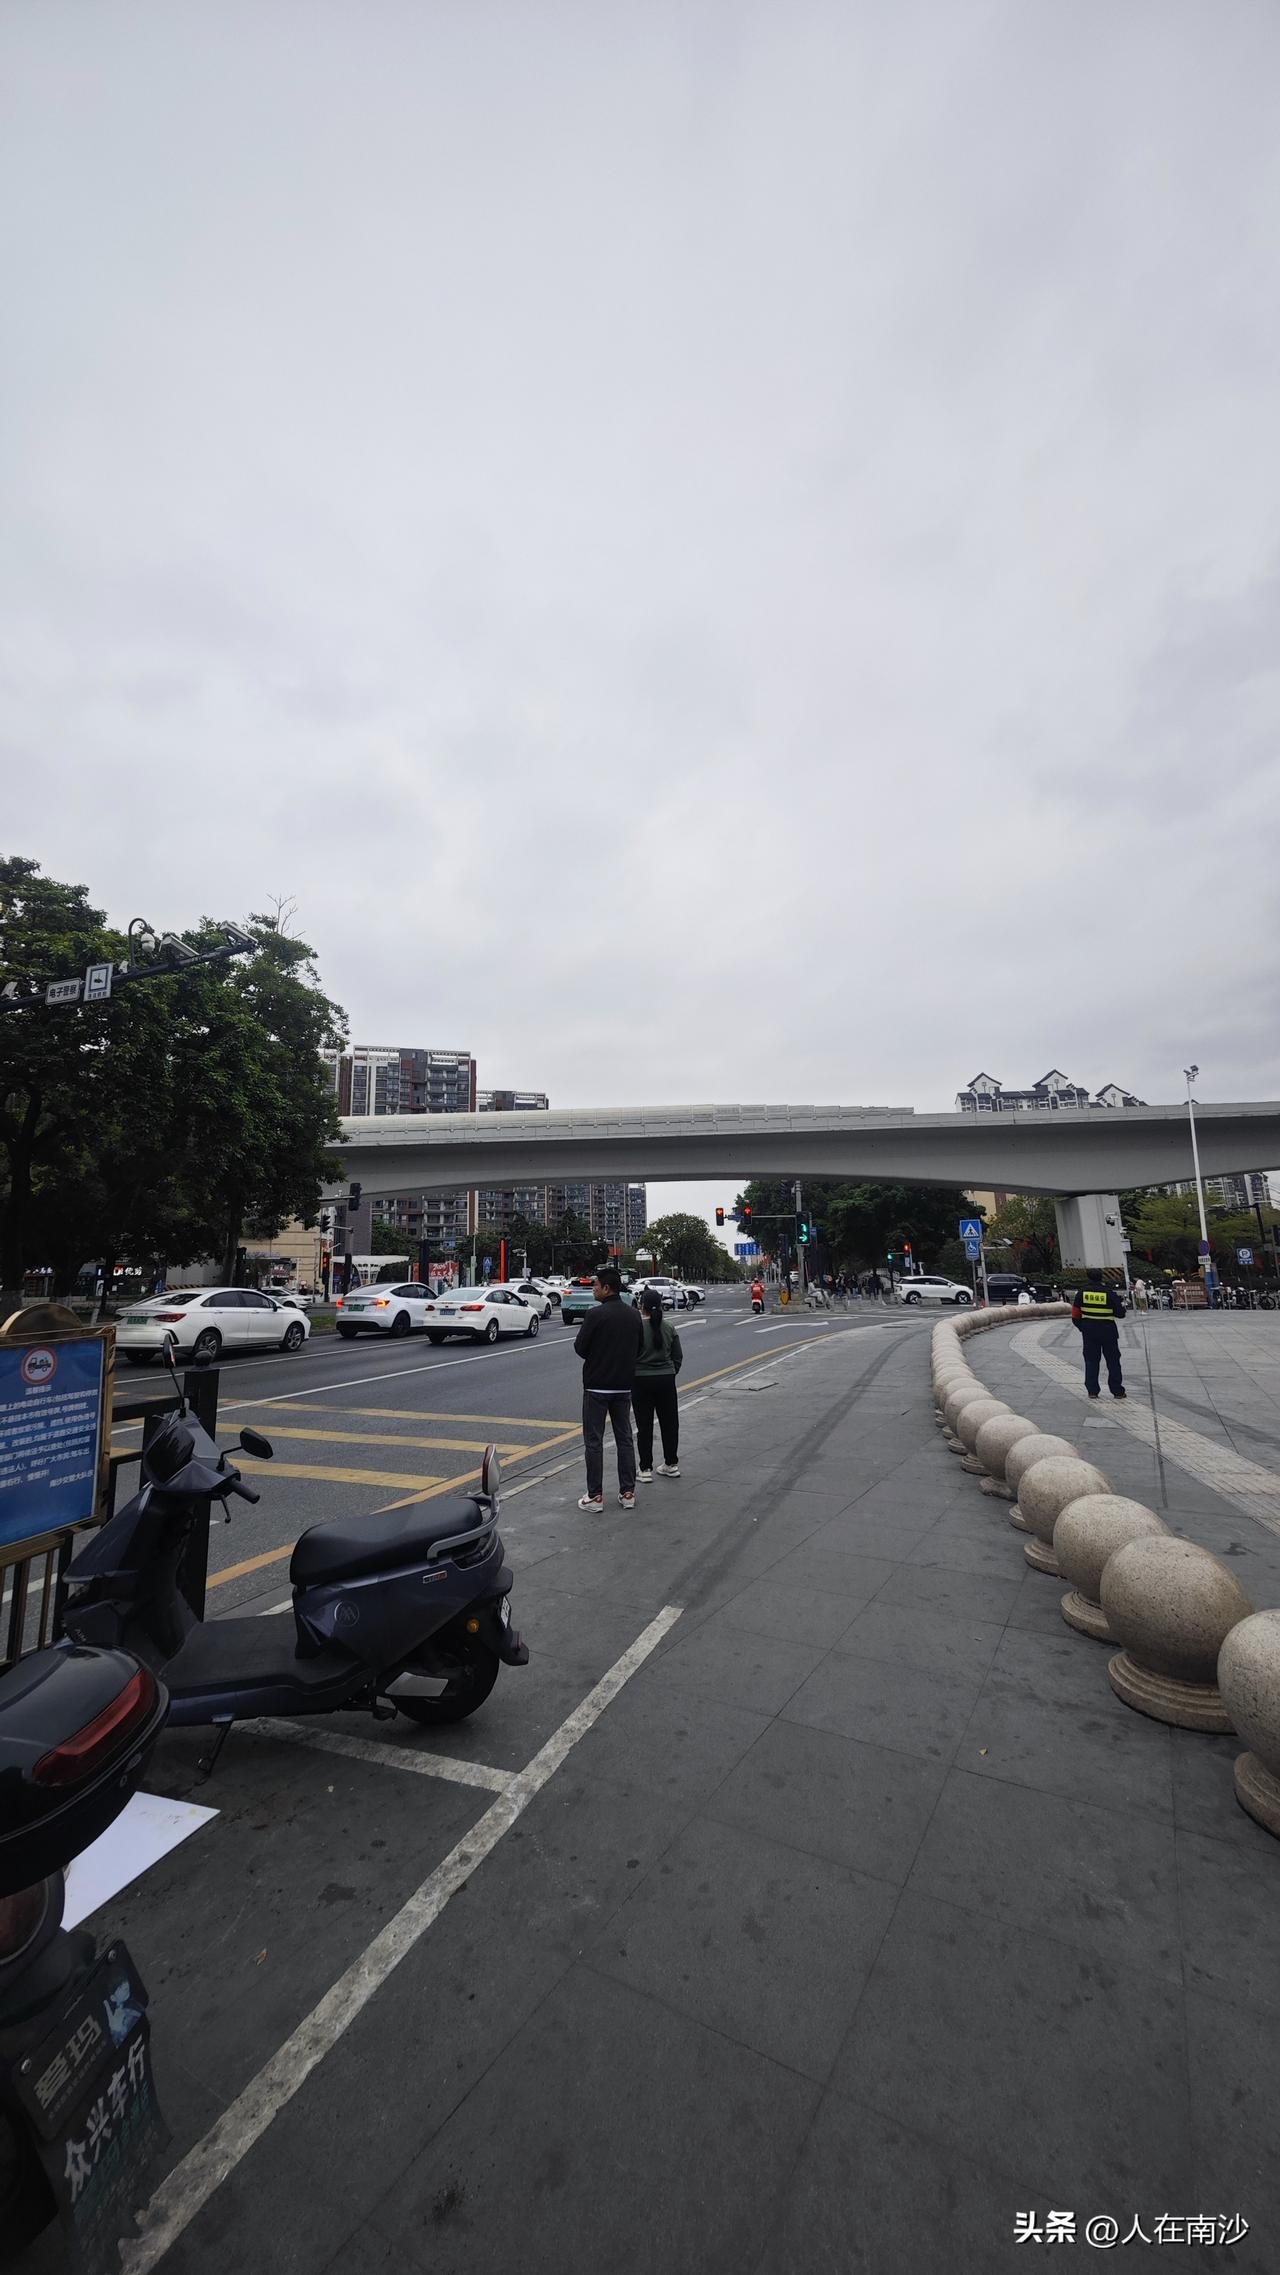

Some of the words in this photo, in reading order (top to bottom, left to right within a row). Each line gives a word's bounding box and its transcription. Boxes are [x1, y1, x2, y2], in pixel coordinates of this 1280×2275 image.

[49, 985, 77, 998] 电子警察
[34, 2015, 102, 2110] 爱玛
[64, 2034, 146, 2204] 众兴车行
